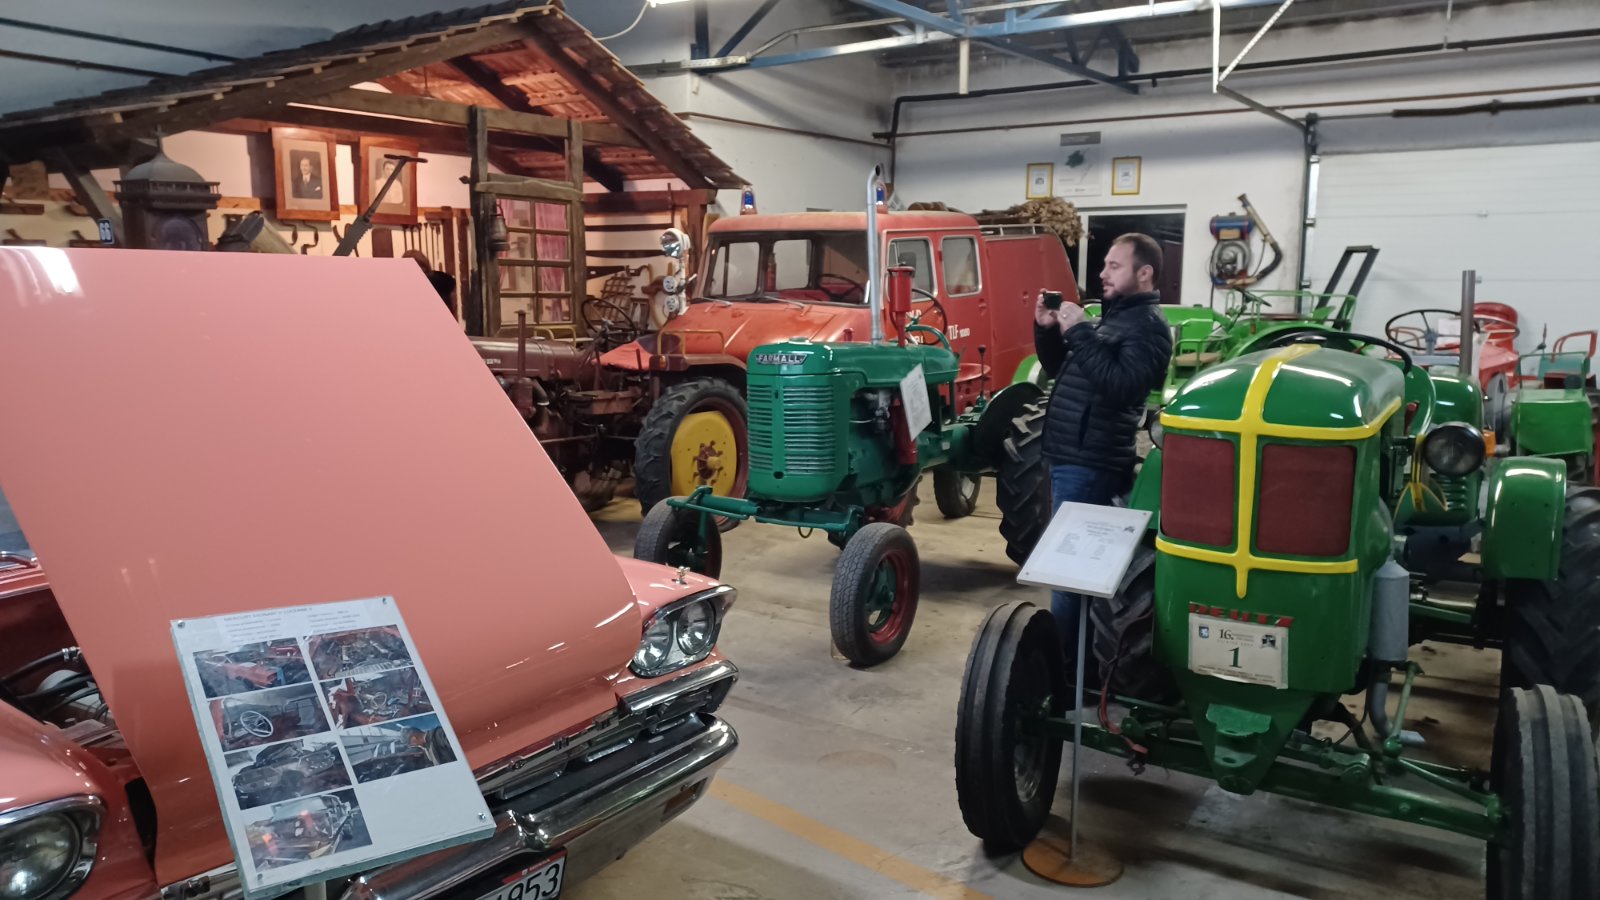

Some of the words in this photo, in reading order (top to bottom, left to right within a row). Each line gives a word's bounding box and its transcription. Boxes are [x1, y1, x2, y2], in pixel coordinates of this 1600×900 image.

[758, 354, 806, 364] FARMALL
[1219, 629, 1234, 640] 16.
[1229, 647, 1242, 668] 1
[496, 863, 560, 900] 953
